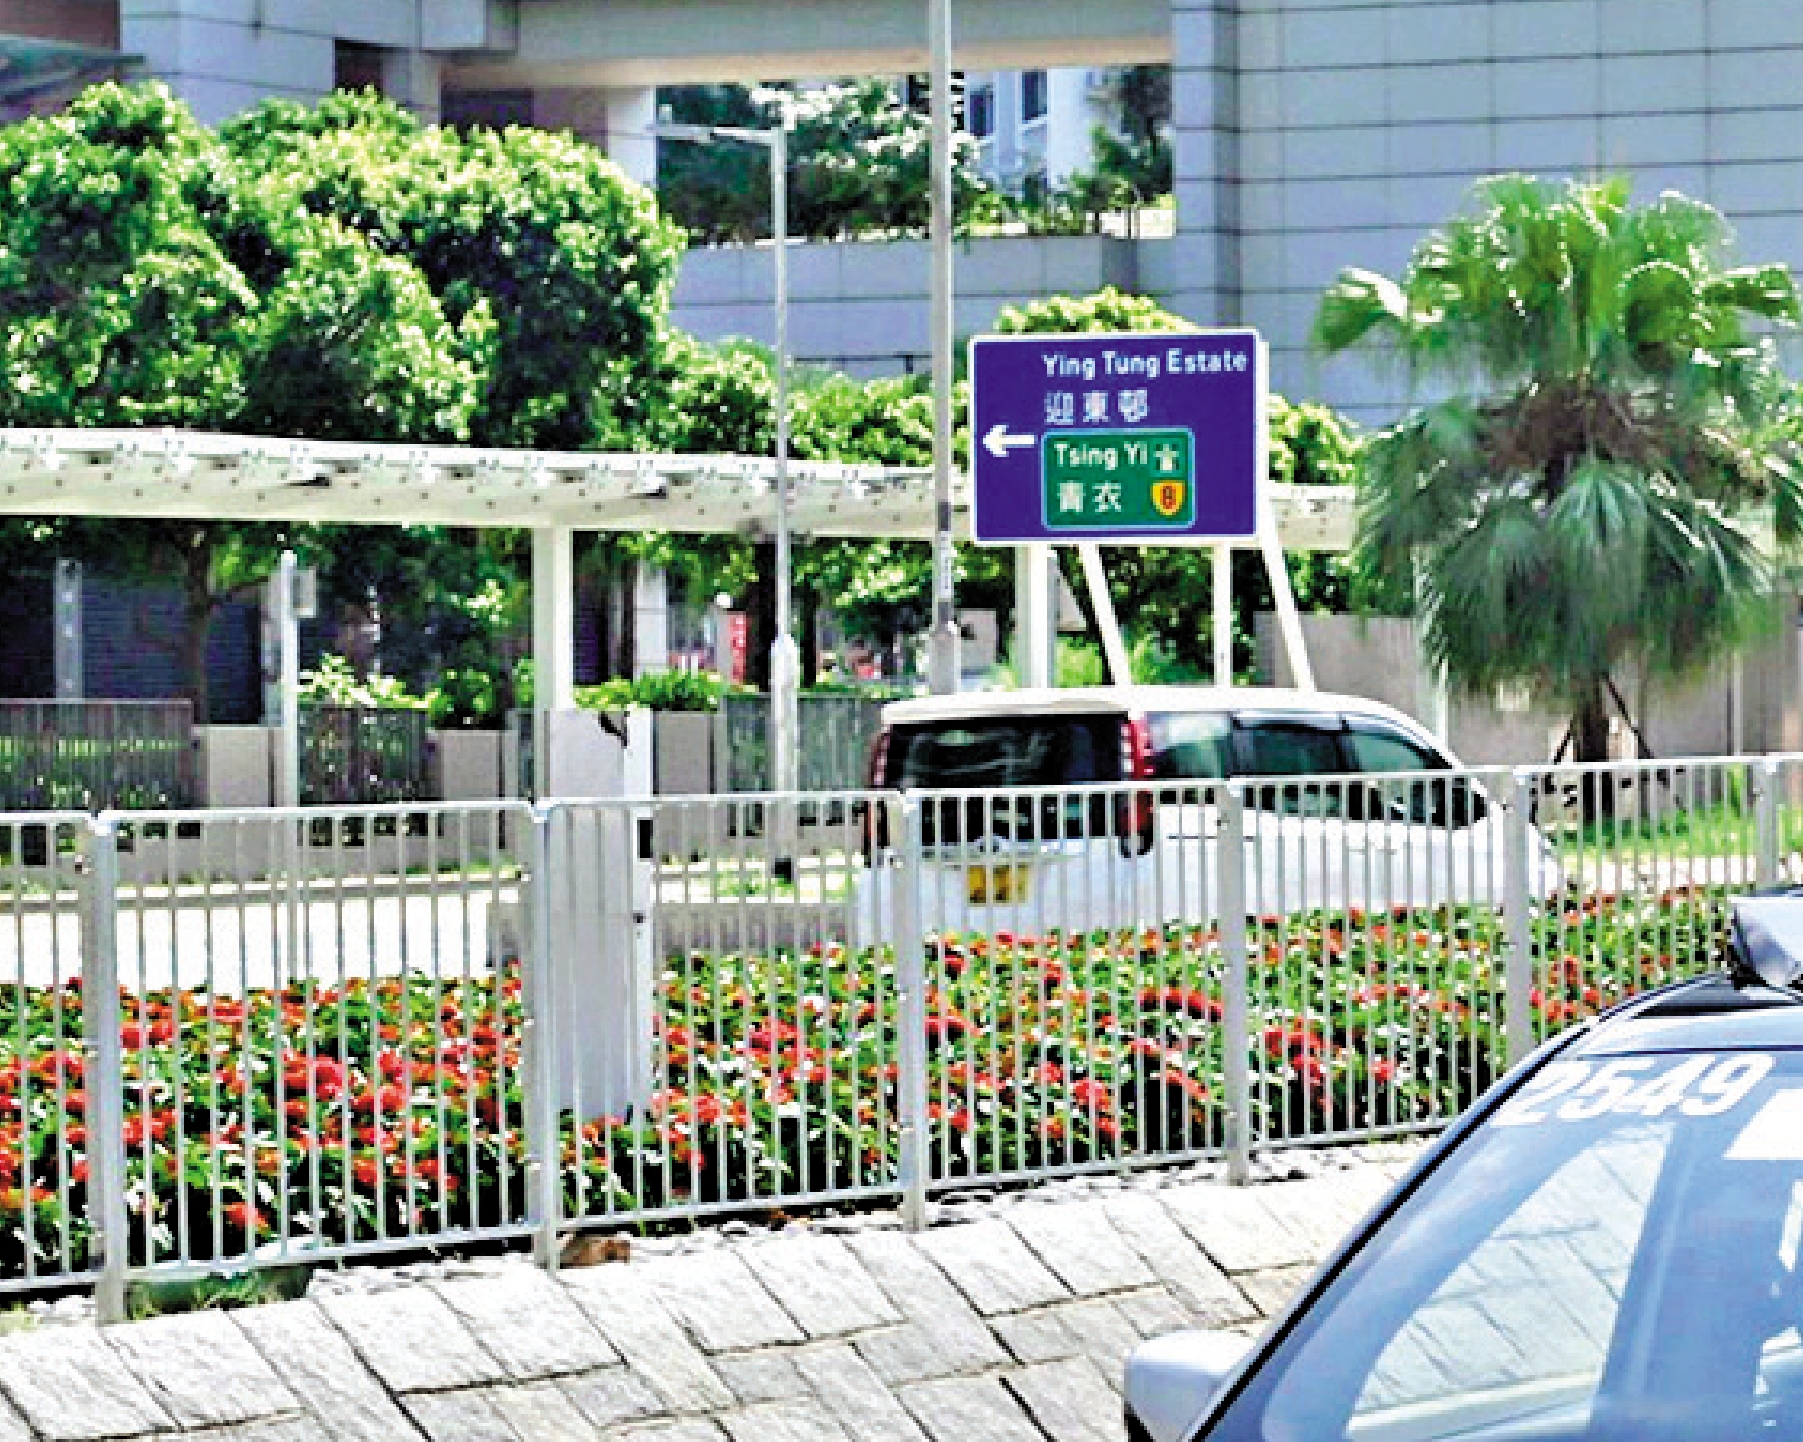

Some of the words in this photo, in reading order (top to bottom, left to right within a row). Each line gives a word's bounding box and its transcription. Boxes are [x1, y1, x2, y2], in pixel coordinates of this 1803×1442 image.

[1042, 353, 1096, 380] Ying
[1101, 350, 1160, 379] Tung
[1166, 347, 1249, 373] Estate
[1053, 440, 1119, 471] Tsing
[1123, 440, 1148, 465] Yi
[1490, 1053, 1775, 1127] 2549
